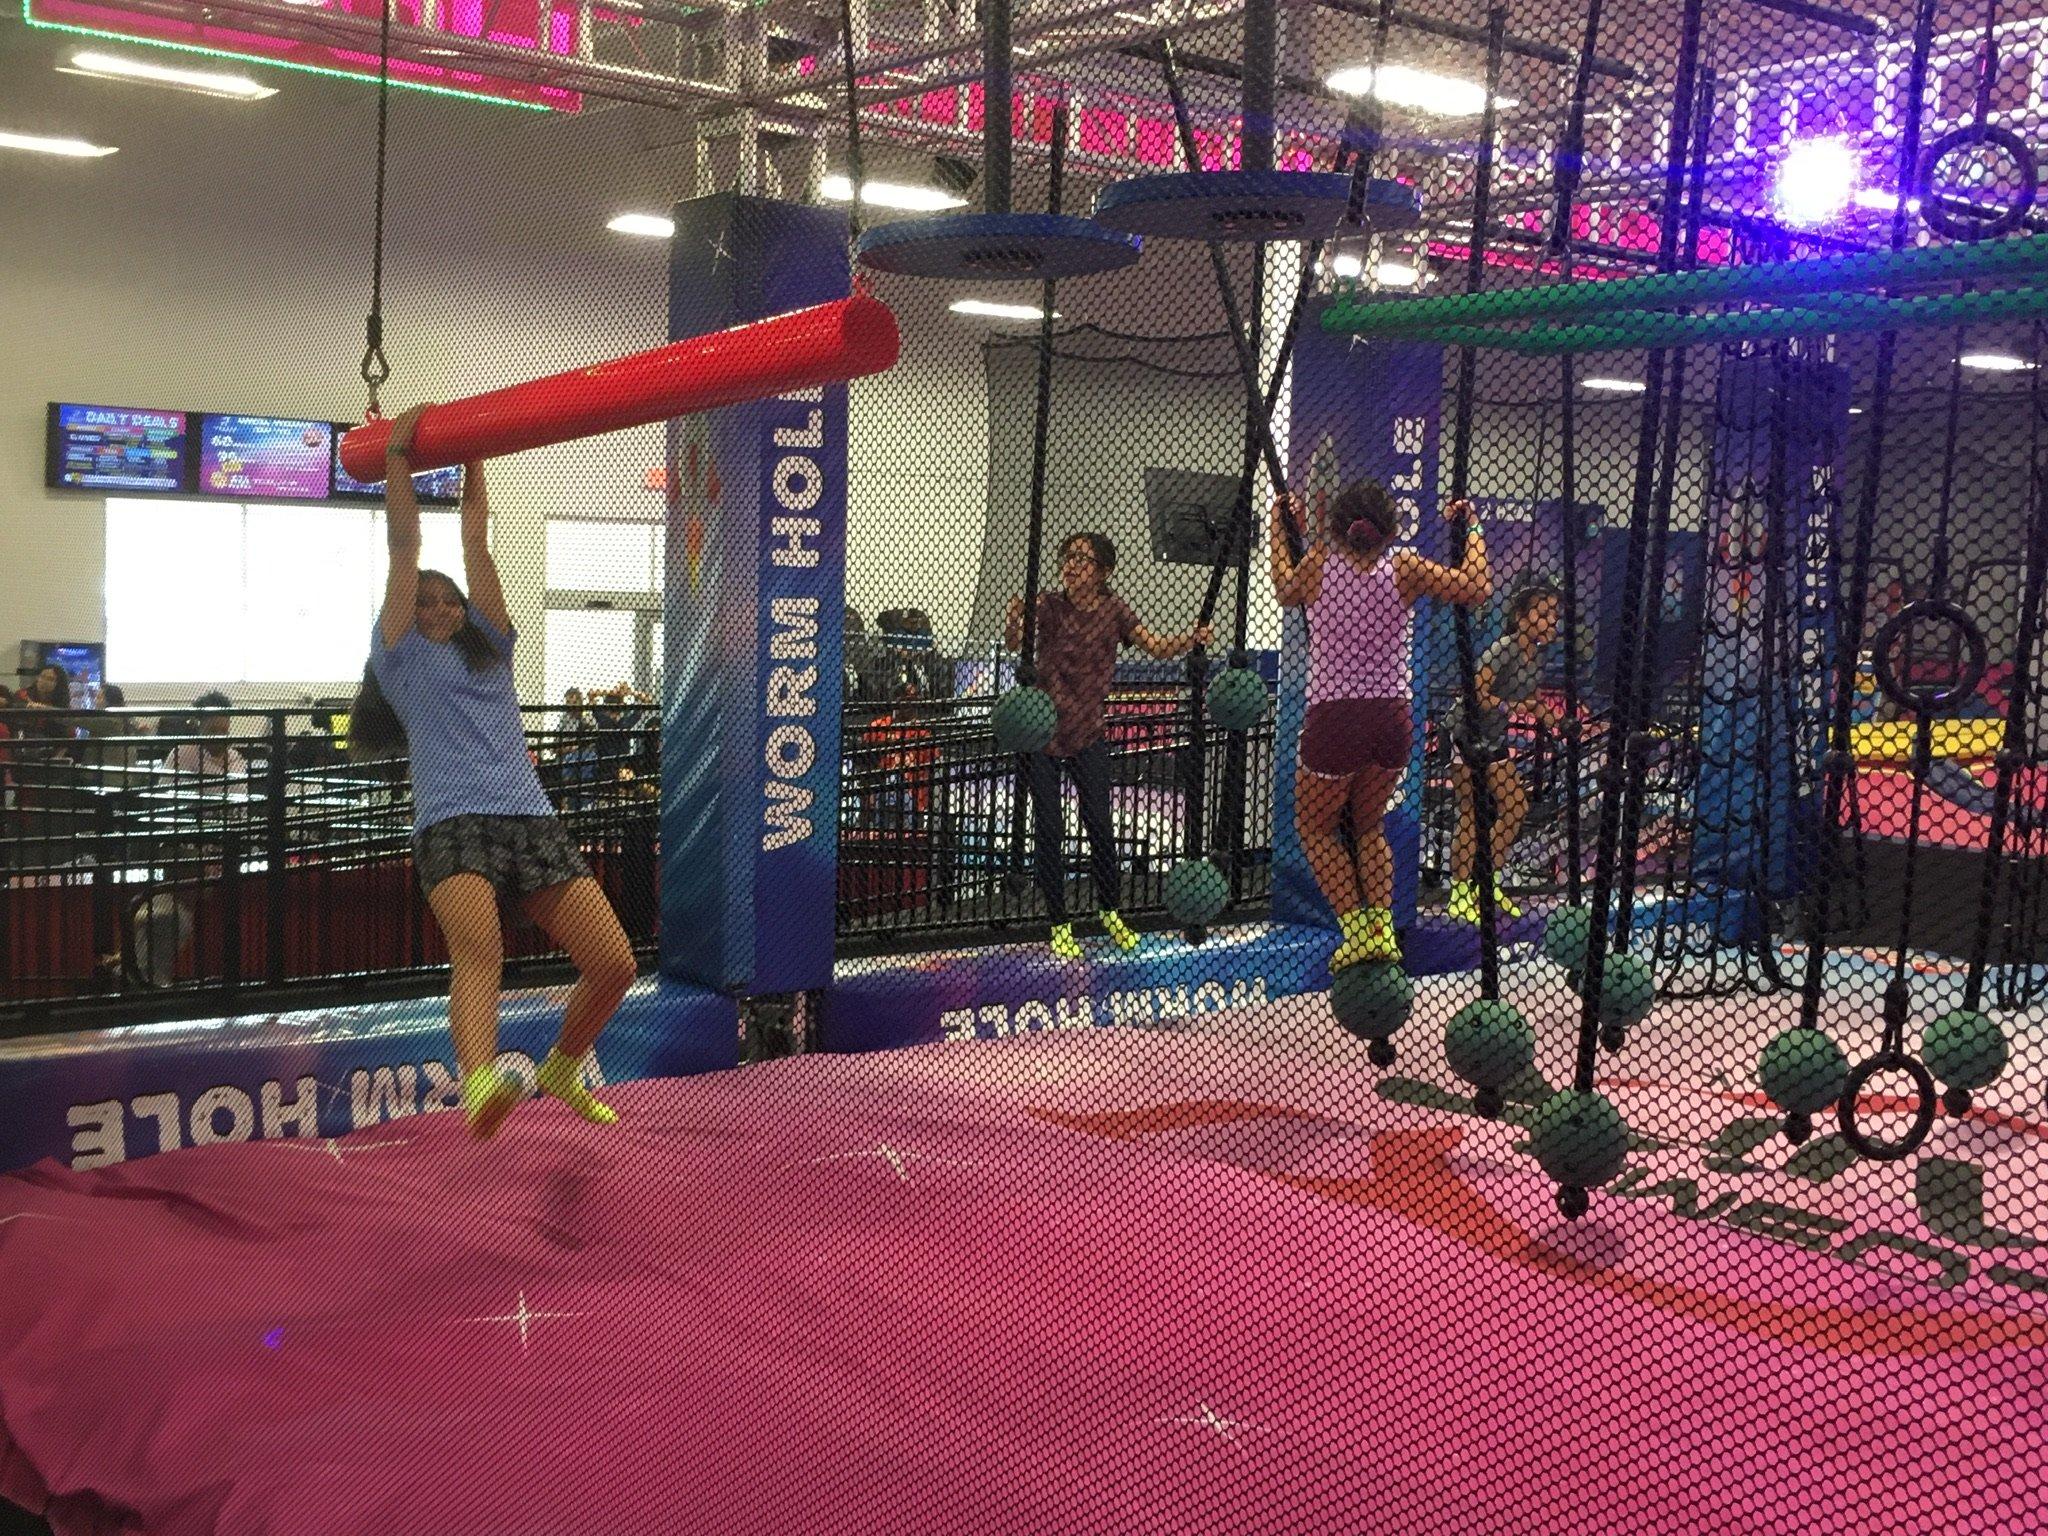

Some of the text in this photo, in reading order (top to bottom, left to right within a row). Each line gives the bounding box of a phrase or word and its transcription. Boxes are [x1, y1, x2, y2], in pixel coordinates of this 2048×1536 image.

[85, 410, 180, 429] DAILY DEALS
[1389, 416, 1427, 558] OLE
[762, 597, 820, 851] WORM
[67, 1075, 319, 1172] HOLE
